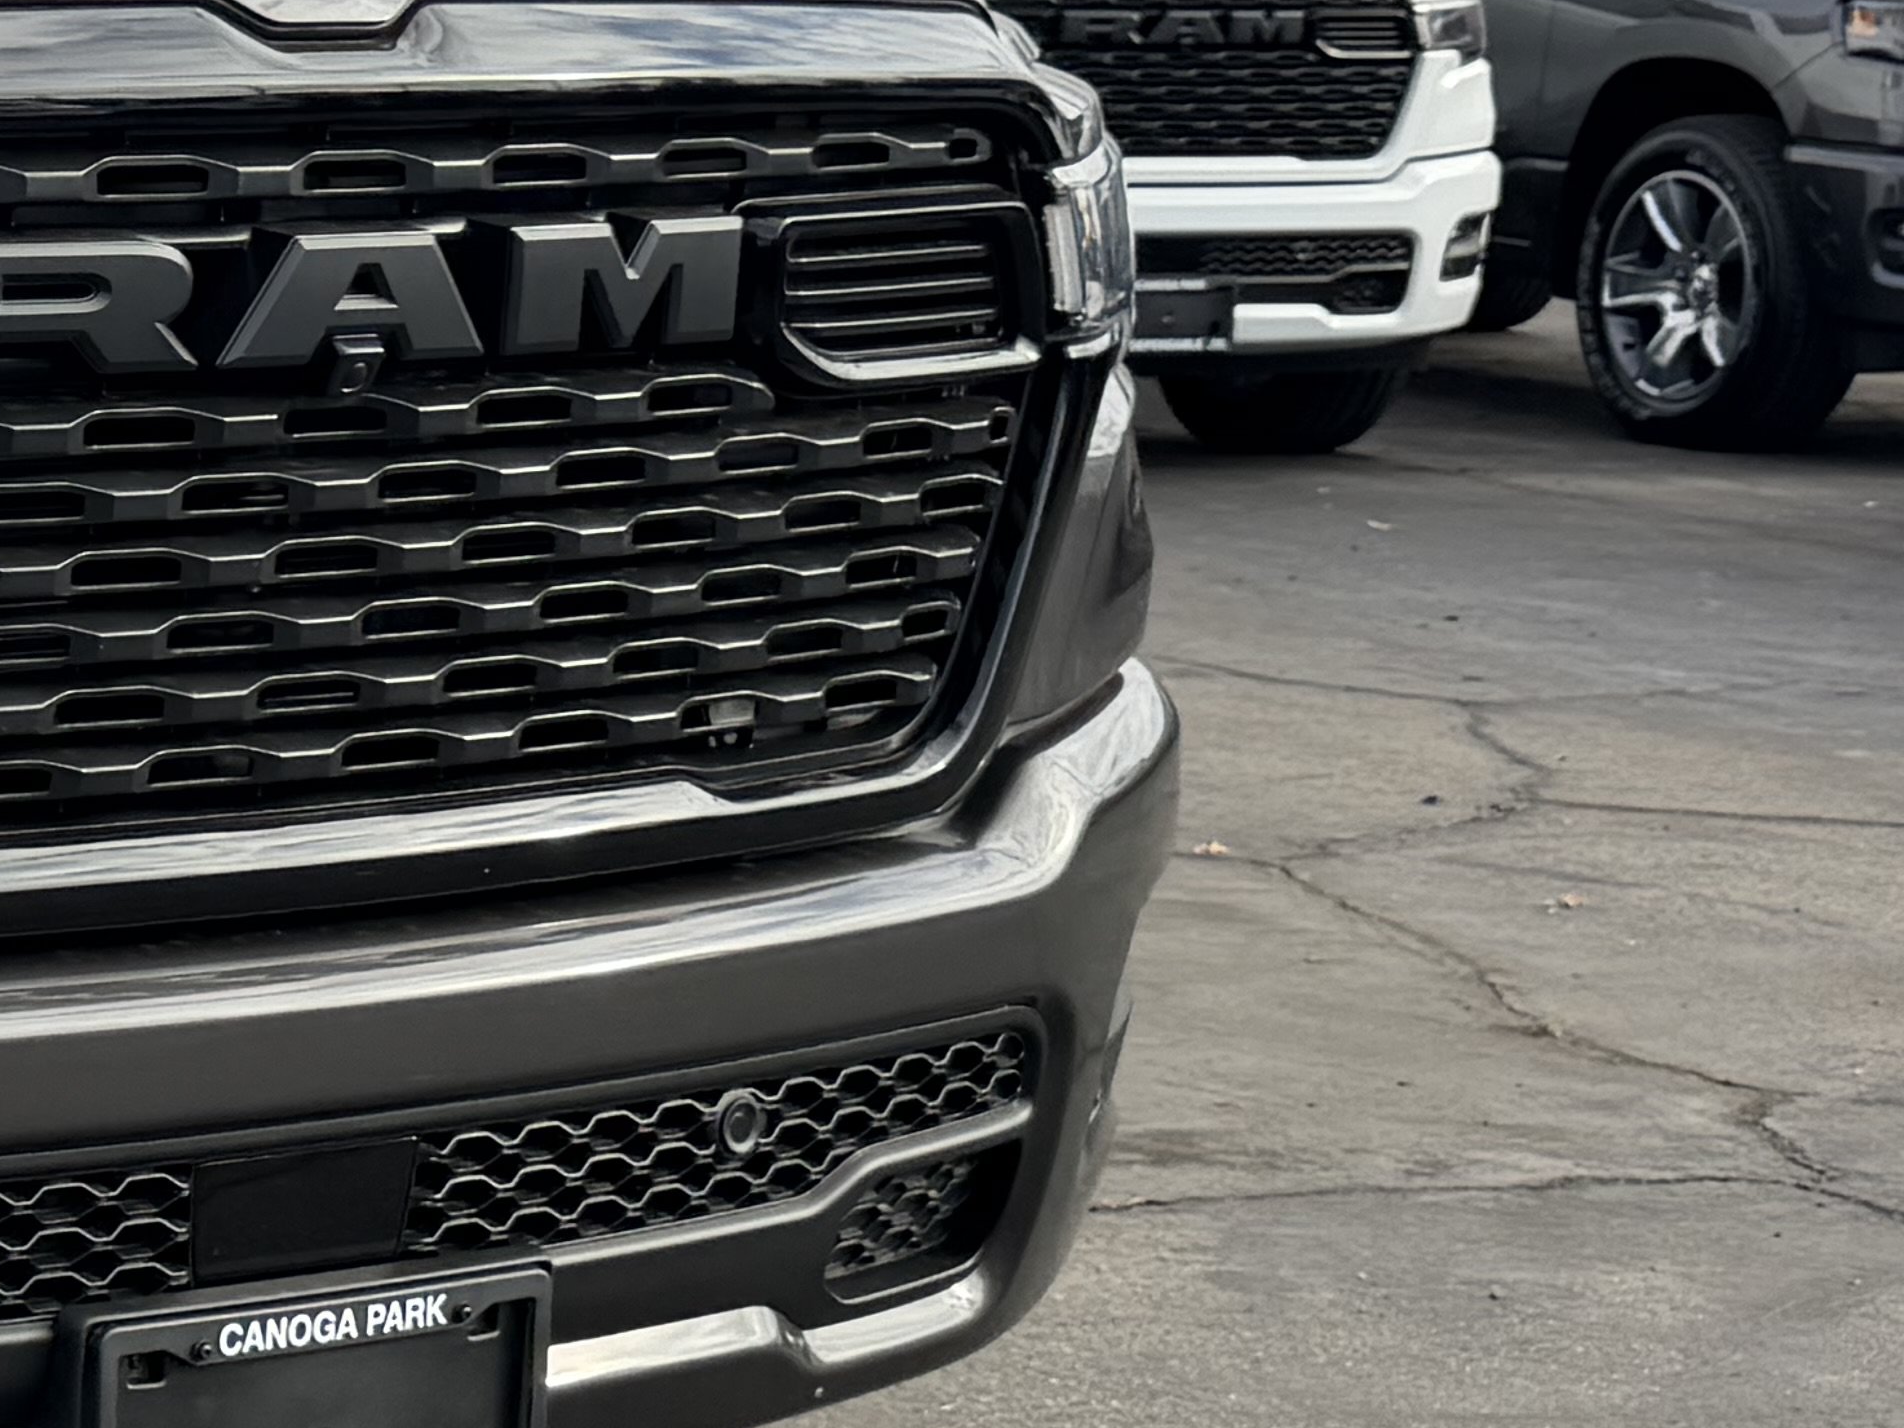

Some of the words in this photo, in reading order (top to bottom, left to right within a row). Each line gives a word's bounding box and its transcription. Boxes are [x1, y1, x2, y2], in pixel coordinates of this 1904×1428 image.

[1061, 8, 1305, 46] RAM
[219, 1305, 359, 1358] CANOGA
[365, 1292, 449, 1337] PARK
